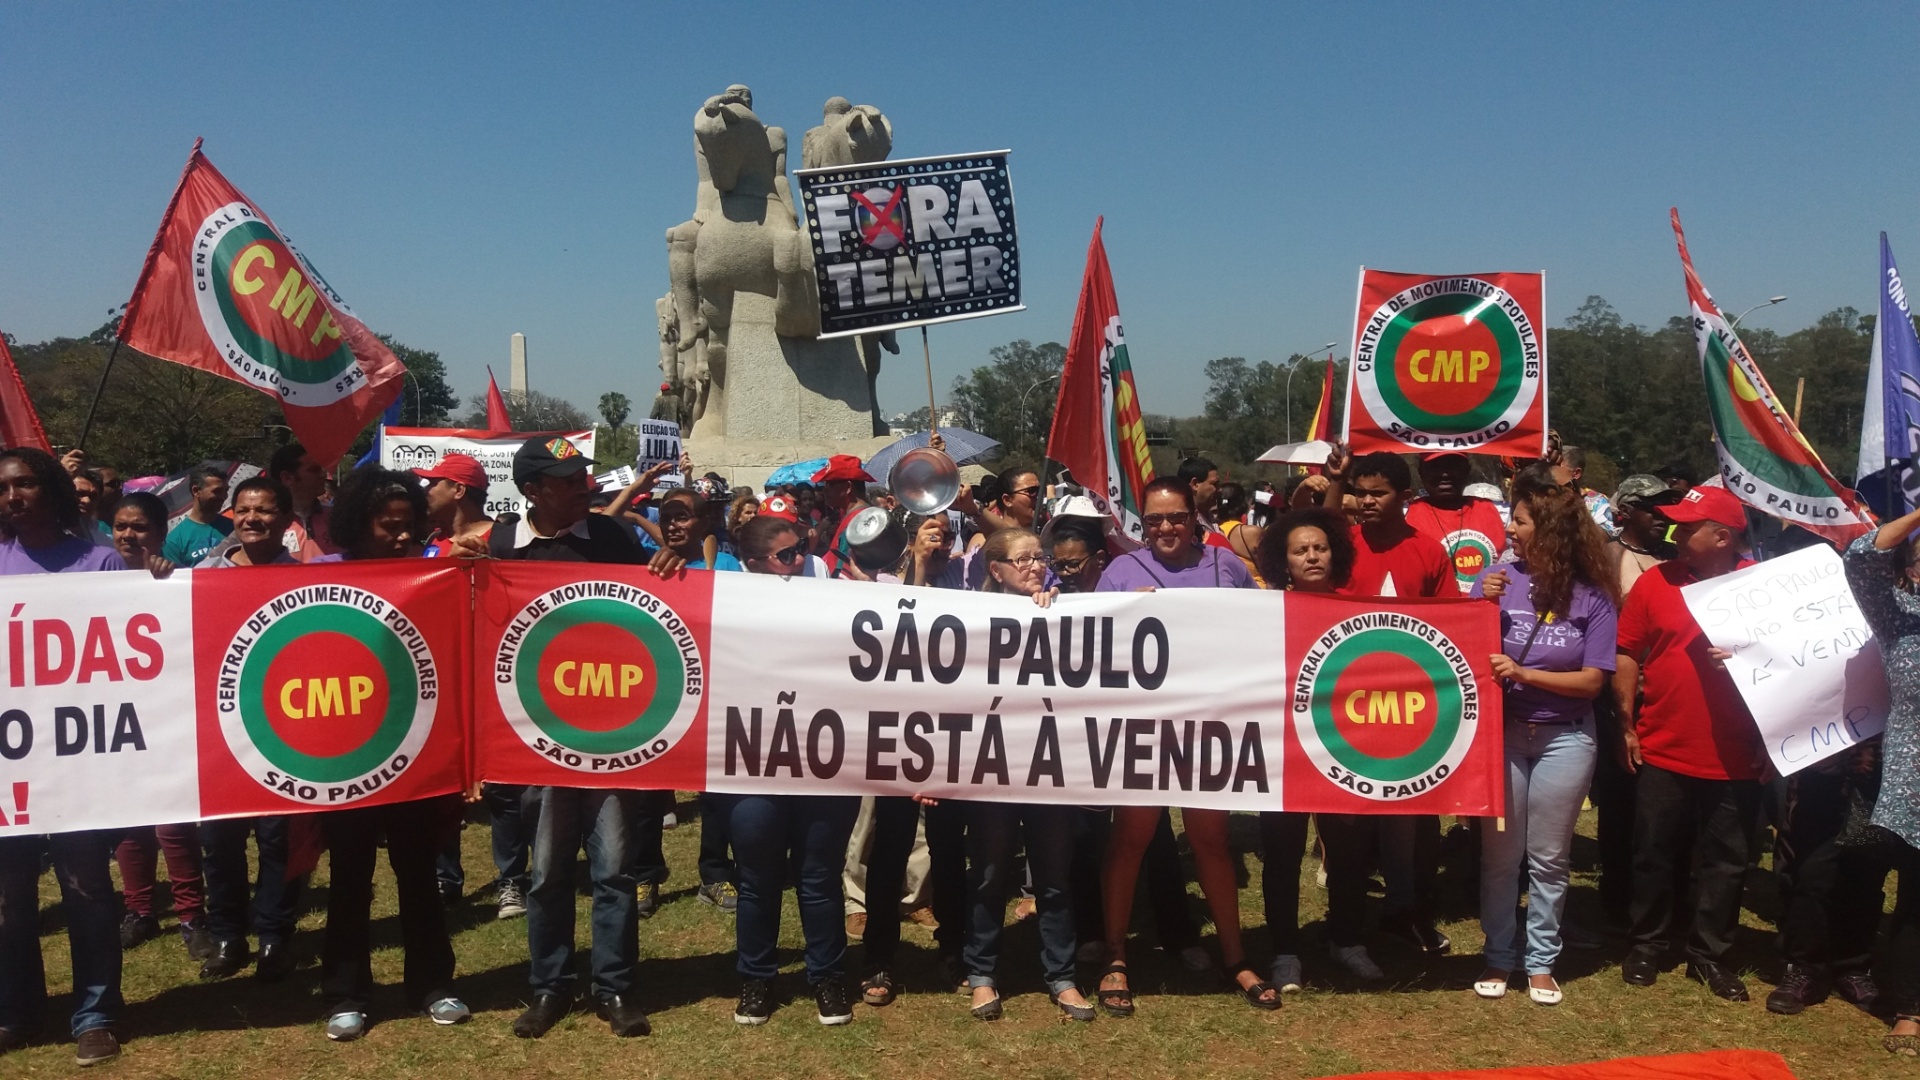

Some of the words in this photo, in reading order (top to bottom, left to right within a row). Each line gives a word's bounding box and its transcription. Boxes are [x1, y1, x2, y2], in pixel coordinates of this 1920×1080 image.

[197, 212, 236, 292] CENTRAL
[232, 244, 342, 347] CMP
[827, 245, 1007, 311] TEMER
[1357, 310, 1391, 373] CENTRAL
[1387, 293, 1409, 313] DE
[1410, 279, 1505, 303] MOVIMENTOS
[1502, 297, 1539, 379] POPULARES
[228, 350, 251, 373] SÃO
[1409, 348, 1491, 384] CMP
[642, 424, 669, 438] ELEIÇÃO
[646, 438, 680, 461] LULA
[1387, 421, 1430, 447] SÃO
[1438, 419, 1511, 448] PAULO
[491, 460, 512, 469] ZONA
[1723, 463, 1757, 496] SÃO
[1766, 492, 1841, 520] PAULO
[1455, 554, 1483, 568] CMP
[1706, 580, 1773, 628] SÃO
[1765, 561, 1840, 596] PAULO
[8, 602, 165, 687] ÍDAS
[219, 635, 254, 713] CENTRAL
[246, 610, 272, 635] DE
[269, 586, 386, 617] MOVIMENTOS
[383, 608, 437, 701] POPULARES
[496, 617, 532, 684] CENTRAL
[525, 598, 550, 619] DE
[549, 582, 661, 614] MOVIMENTOS
[657, 608, 703, 697] POPULARES
[849, 597, 968, 685] SÃO
[986, 615, 1170, 691] PAULO
[1733, 617, 1783, 655] NÃO
[1791, 621, 1873, 668] VENDA
[553, 660, 644, 699] CMP
[1294, 648, 1326, 714] CENTRAL
[1320, 629, 1342, 650] DE
[1340, 613, 1438, 643] MOVIMENTOS
[1436, 637, 1478, 721] POPULARES
[280, 675, 375, 720] CMP
[1344, 689, 1426, 725] CMP
[54, 702, 148, 757] DIA
[532, 737, 583, 767] SÃO
[591, 738, 669, 771] PAULO
[724, 690, 846, 780] NÃO
[865, 696, 1010, 785] ESTÁ
[1026, 697, 1066, 788] À
[1084, 716, 1270, 794] VENDA
[1780, 705, 1870, 763] CMP
[262, 770, 318, 801] SÃO
[327, 753, 410, 802] PAULO
[1327, 765, 1375, 796] SÃO
[1382, 763, 1451, 798] PAULO
